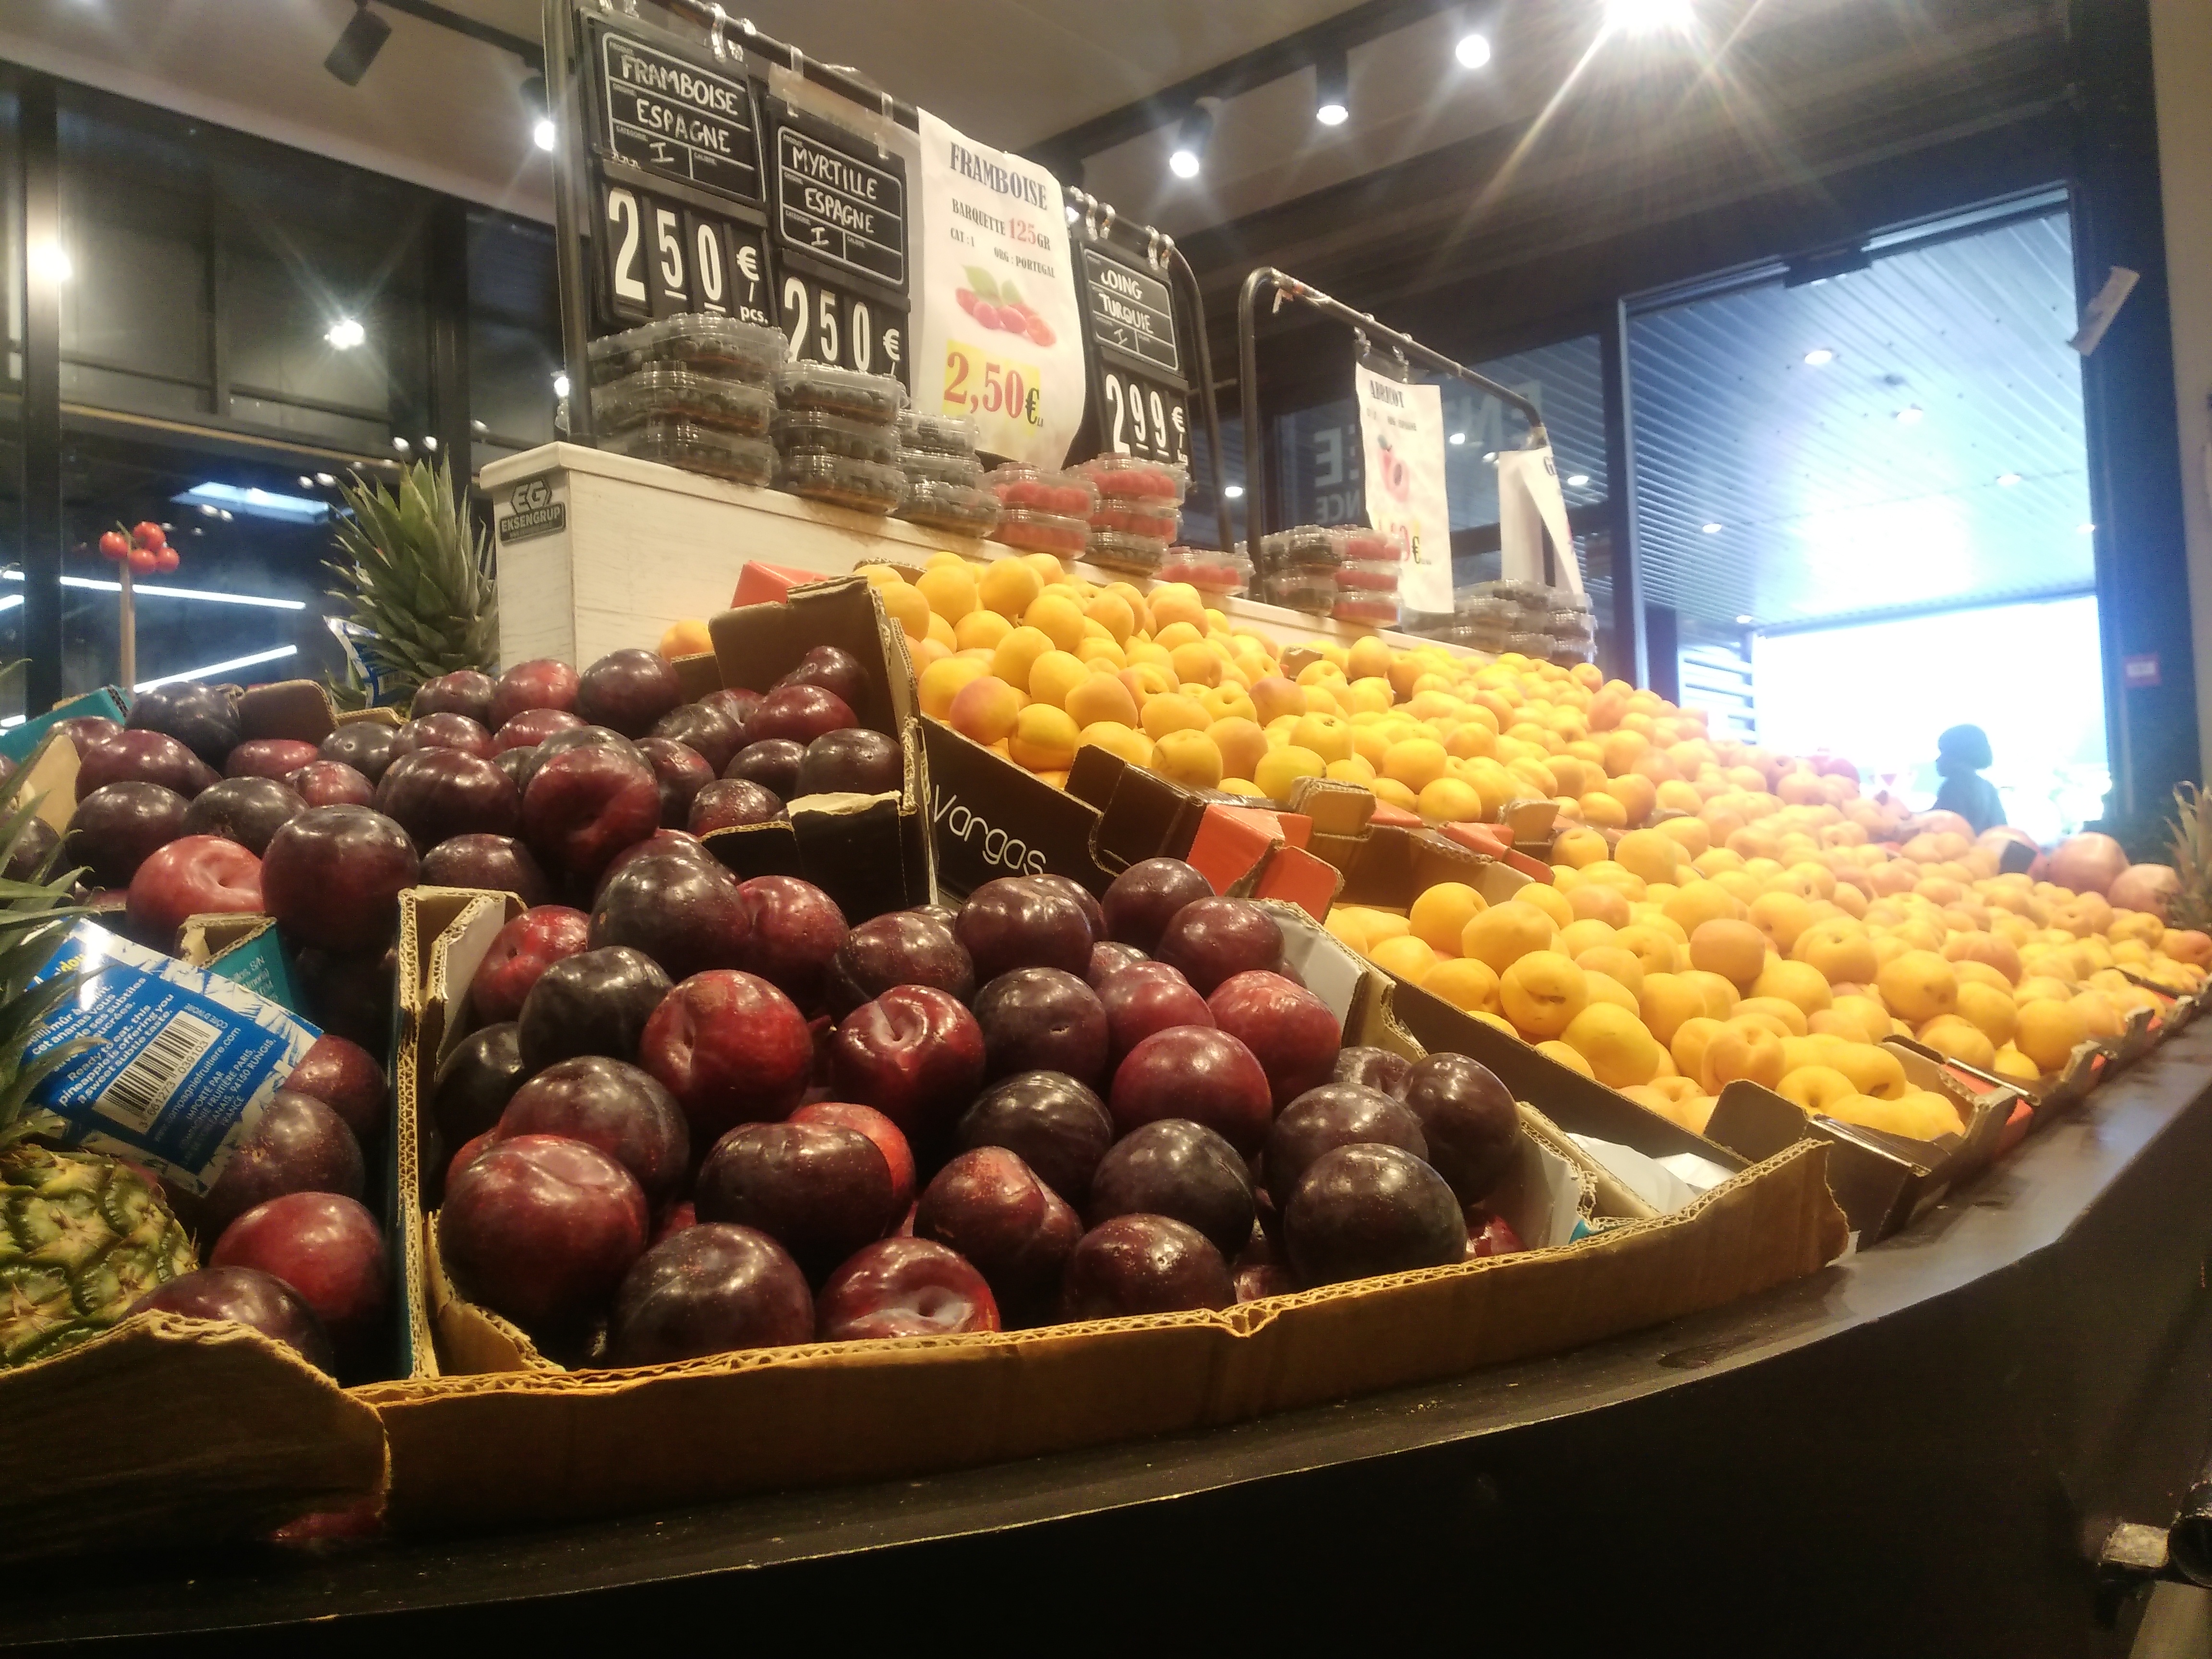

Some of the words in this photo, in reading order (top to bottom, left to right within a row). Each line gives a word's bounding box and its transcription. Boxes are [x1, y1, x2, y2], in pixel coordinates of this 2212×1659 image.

[621, 53, 738, 116] FRAMBOISE
[636, 98, 731, 153] ESPAGNE
[793, 145, 878, 200] MYRTILLE
[950, 142, 1047, 211] FRAMBOISE
[805, 187, 874, 234] ESPAGNE
[952, 198, 1006, 236] BARQUETTE
[950, 228, 964, 243] CAT
[994, 246, 1010, 263] ORG
[1015, 255, 1055, 278] PORTUGAL
[740, 305, 768, 324] pcs.
[1098, 292, 1154, 335] TURQUIE
[511, 480, 548, 513] EG
[501, 506, 560, 532] EKSENGRUP
[933, 784, 1046, 875] Vargas
[108, 978, 146, 1013] subtiles
[51, 1016, 91, 1044] ananas
[90, 994, 116, 1014] vous
[59, 1059, 109, 1106] pineapple
[119, 1012, 157, 1049] offering
[155, 994, 173, 1012] you
[67, 1052, 102, 1081] Ready
[131, 1005, 151, 1023] this
[85, 1066, 115, 1098] sweet
[115, 1036, 146, 1067] subtle
[144, 1010, 173, 1036] taste.
[178, 1041, 208, 1074] 039103
[233, 1049, 255, 1071] PARIS,
[248, 1039, 276, 1070] RUNGIS,
[208, 1070, 224, 1087] PAR
